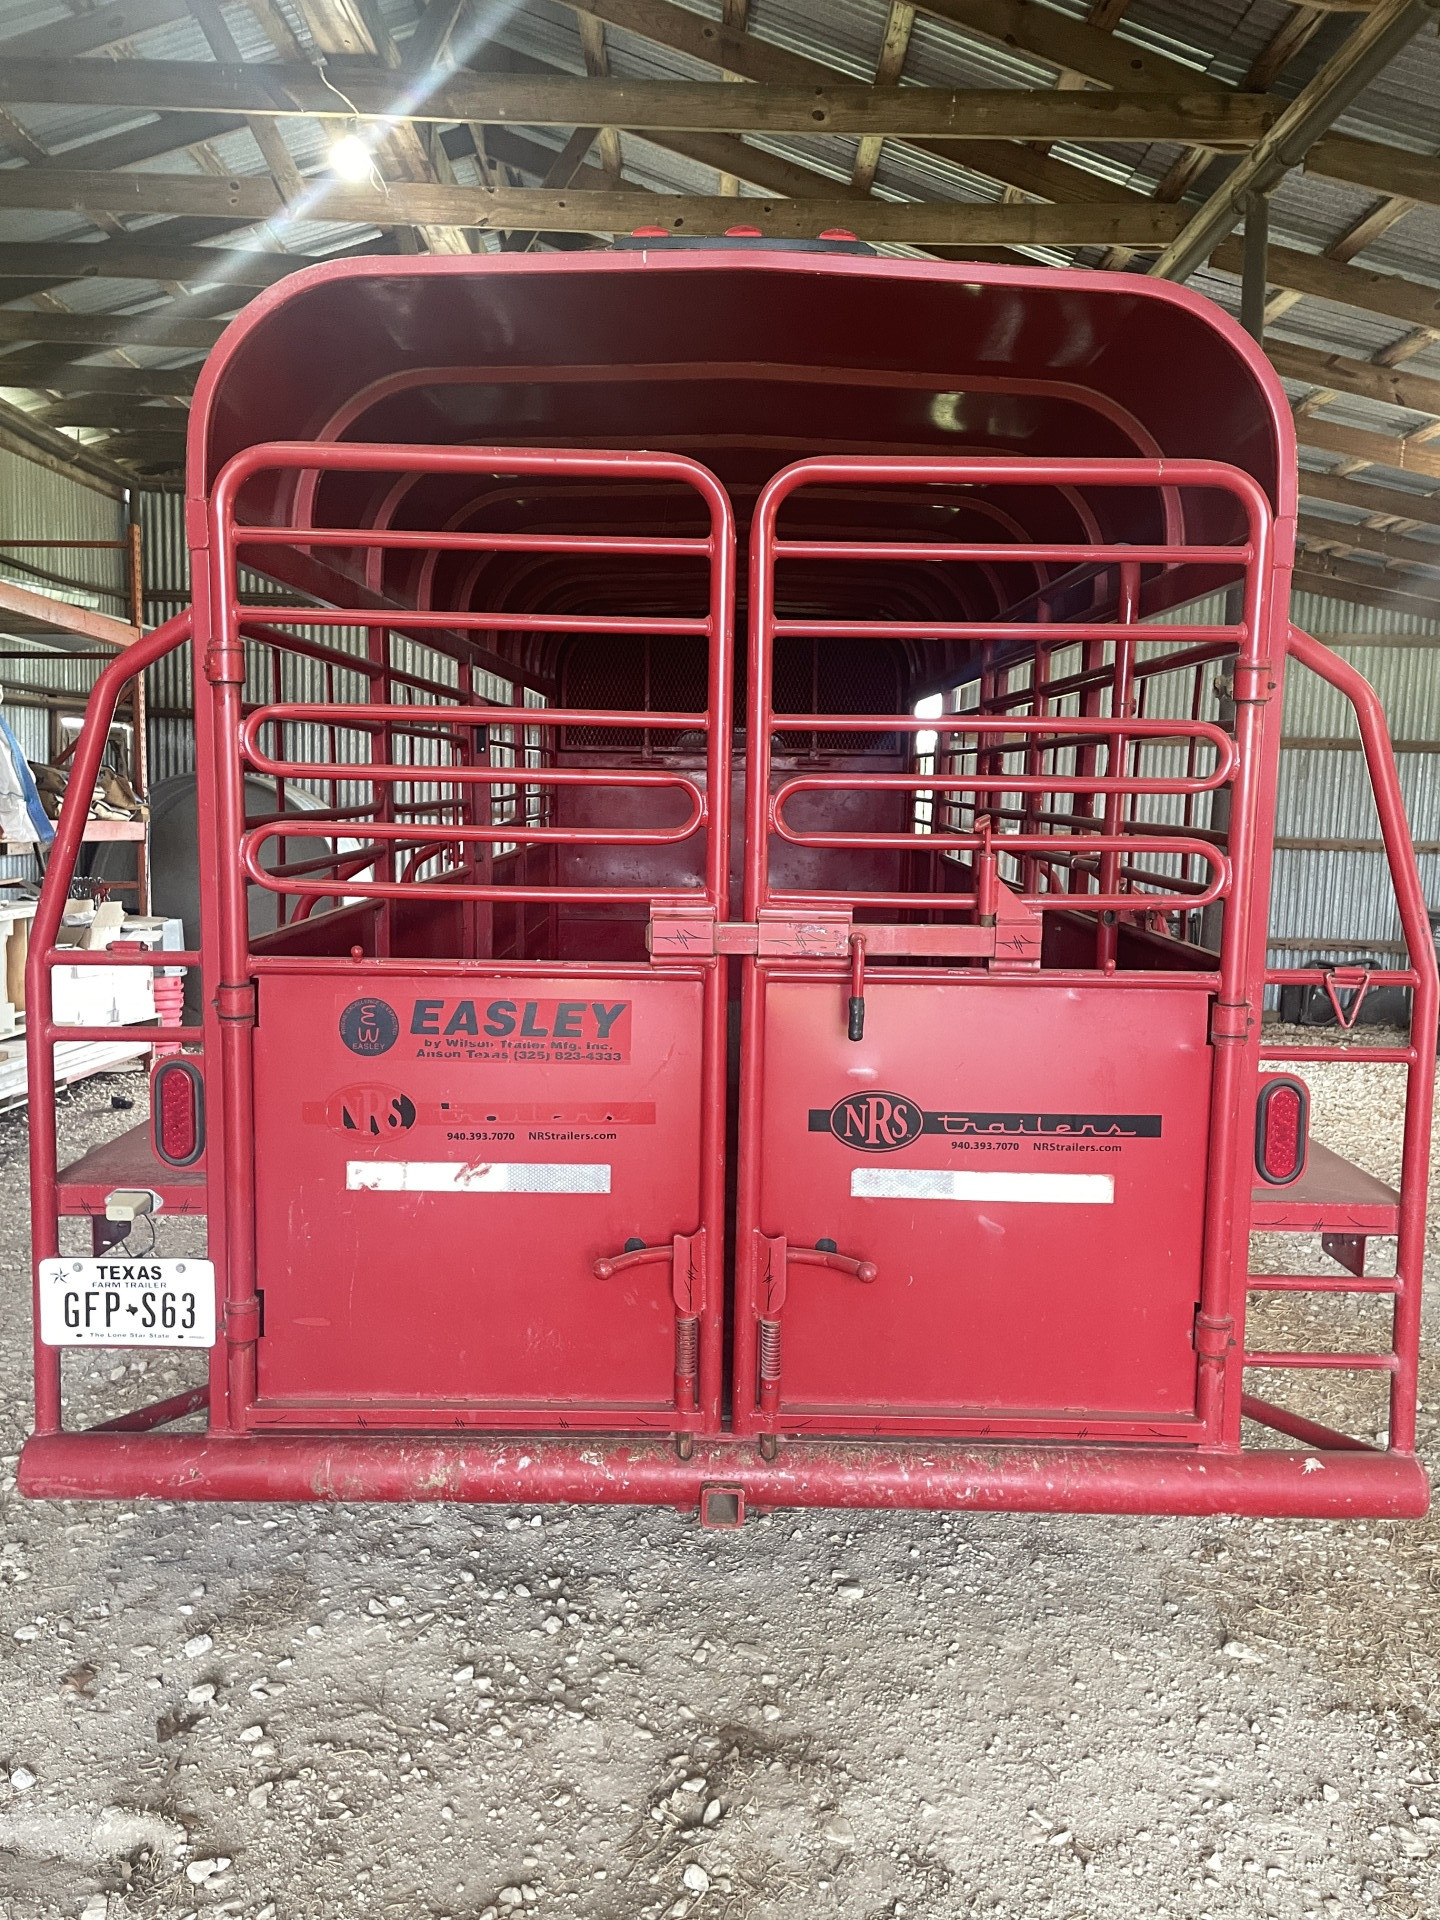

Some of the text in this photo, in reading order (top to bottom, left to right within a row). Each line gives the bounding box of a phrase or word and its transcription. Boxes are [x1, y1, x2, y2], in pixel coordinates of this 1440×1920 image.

[410, 999, 627, 1038] EASLEY
[352, 1042, 385, 1050] EASLEY
[424, 1039, 613, 1051] by Wilson Trailer Mfg. Inc.
[416, 1049, 622, 1061] Anson Texas (325) 823-4333
[845, 1097, 908, 1144] NRS
[937, 1115, 1137, 1136] trailers
[447, 1131, 617, 1141] 940.393.7070 NRStrailers.com
[951, 1141, 1122, 1152] 940.393.7070 NRStrailers.com
[96, 1265, 162, 1280] TEXAS
[92, 1281, 167, 1289] FARM TRAILER
[64, 1291, 196, 1329] GFP S63
